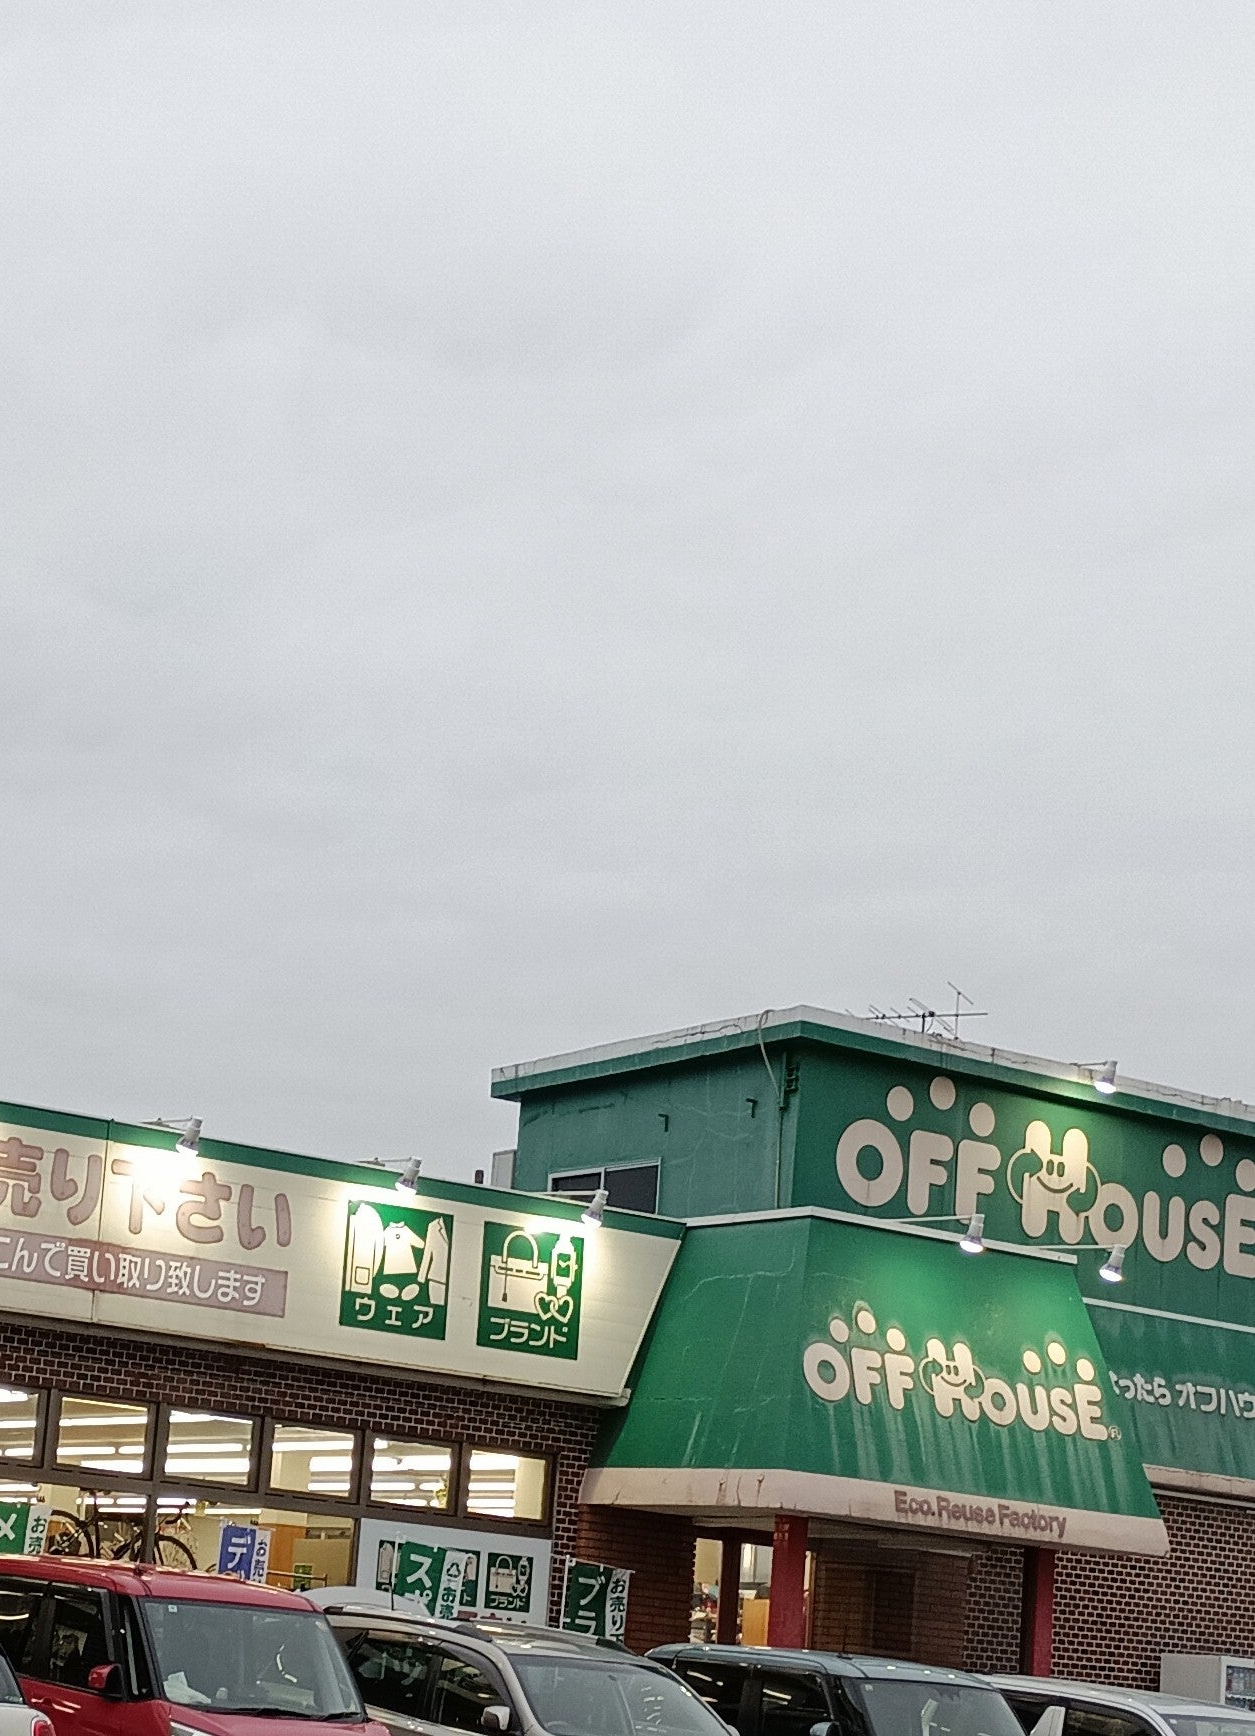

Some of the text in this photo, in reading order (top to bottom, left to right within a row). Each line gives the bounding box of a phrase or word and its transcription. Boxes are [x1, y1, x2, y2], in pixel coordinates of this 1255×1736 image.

[836, 1117, 1255, 1279] OFF HOUSE
[490, 1317, 568, 1349] ブランド
[803, 1338, 1108, 1442] OFF HOUSE
[998, 1503, 1067, 1539] Factory
[253, 1540, 268, 1583] お売
[489, 1595, 526, 1609] ブランド
